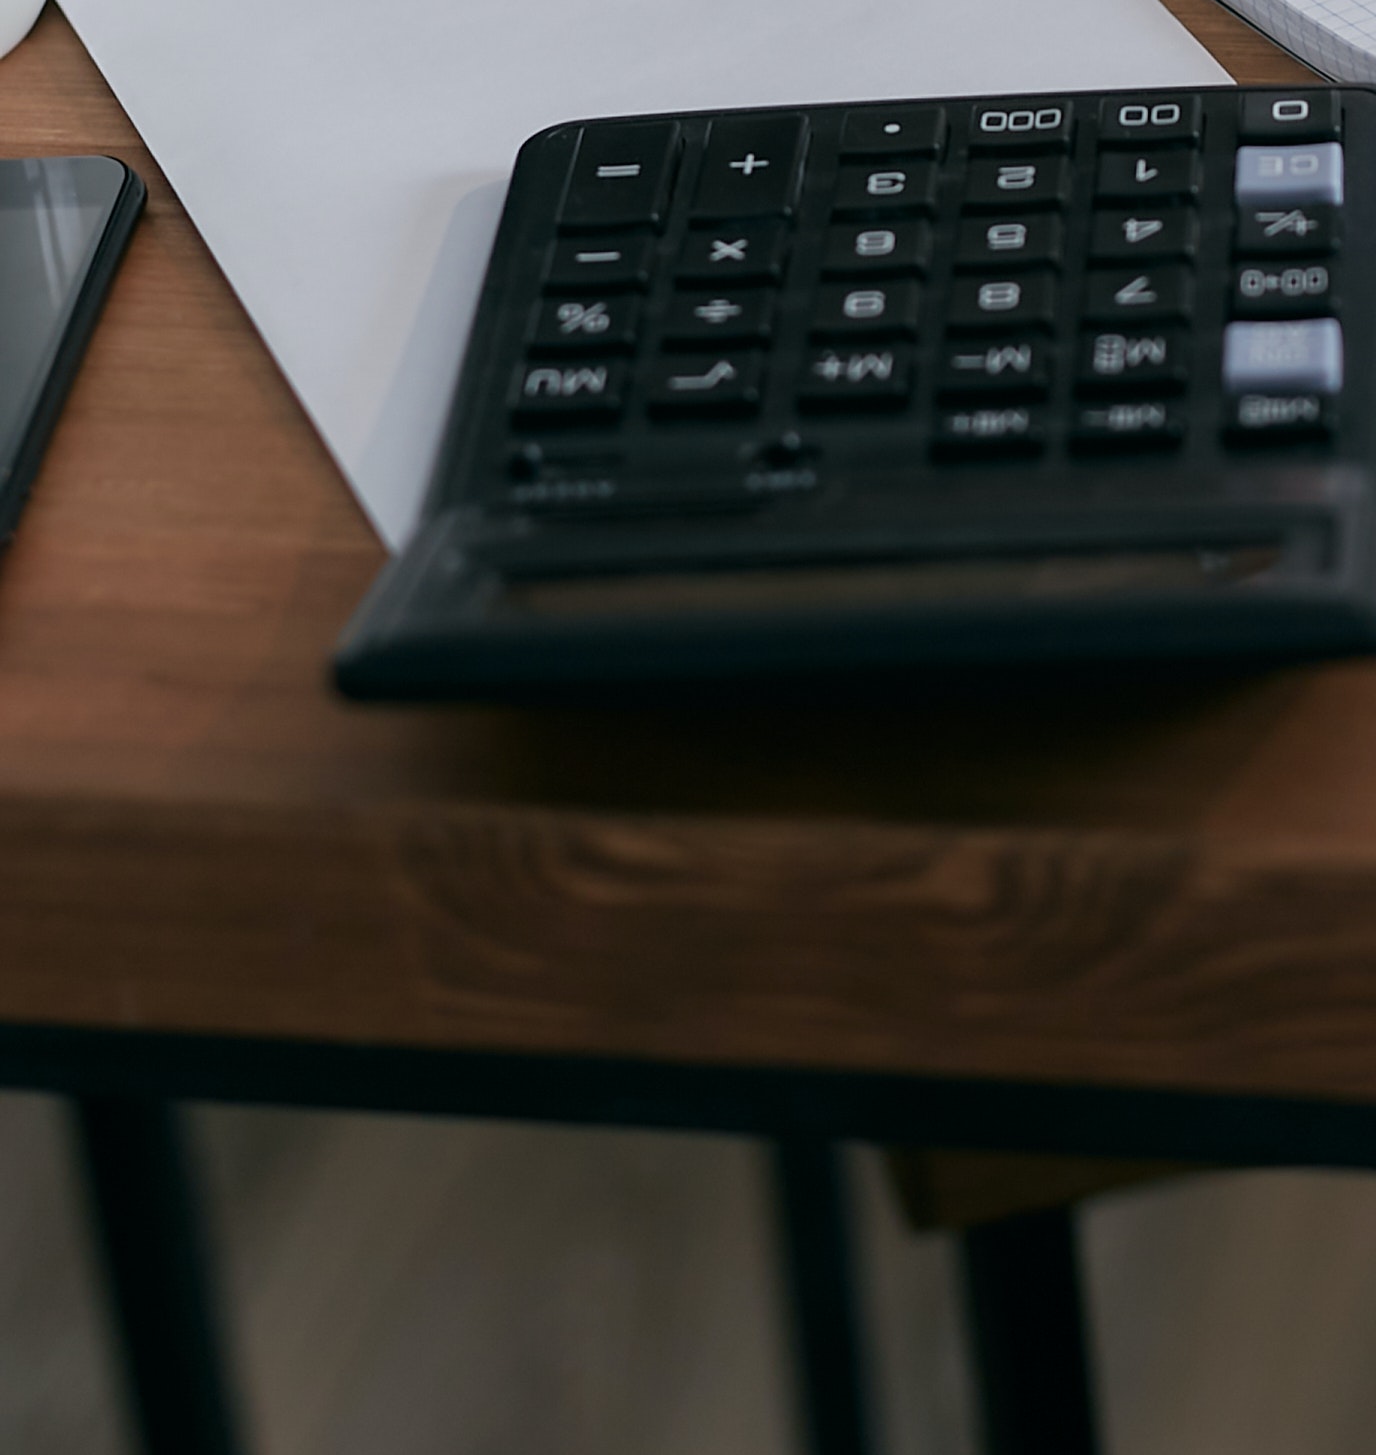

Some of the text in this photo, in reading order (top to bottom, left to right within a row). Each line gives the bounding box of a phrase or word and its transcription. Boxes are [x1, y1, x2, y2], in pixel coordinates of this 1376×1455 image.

[980, 108, 1062, 132] 000
[1119, 104, 1180, 126] 00
[1272, 100, 1309, 121] 0
[596, 164, 641, 177] =
[729, 153, 769, 175] +
[1135, 159, 1157, 182] 1
[1259, 155, 1319, 176] CE
[867, 172, 906, 194] 3
[997, 165, 1036, 189] 2
[987, 223, 1026, 250] 5
[1124, 218, 1162, 242] 4
[856, 230, 896, 255] 6
[979, 282, 1020, 309] 8
[1115, 276, 1153, 304] 7
[696, 299, 739, 323] ÷
[844, 290, 885, 317] 9
[557, 303, 610, 332] %
[818, 354, 893, 380] M+
[957, 347, 1031, 373] M-
[525, 368, 607, 394] MU
